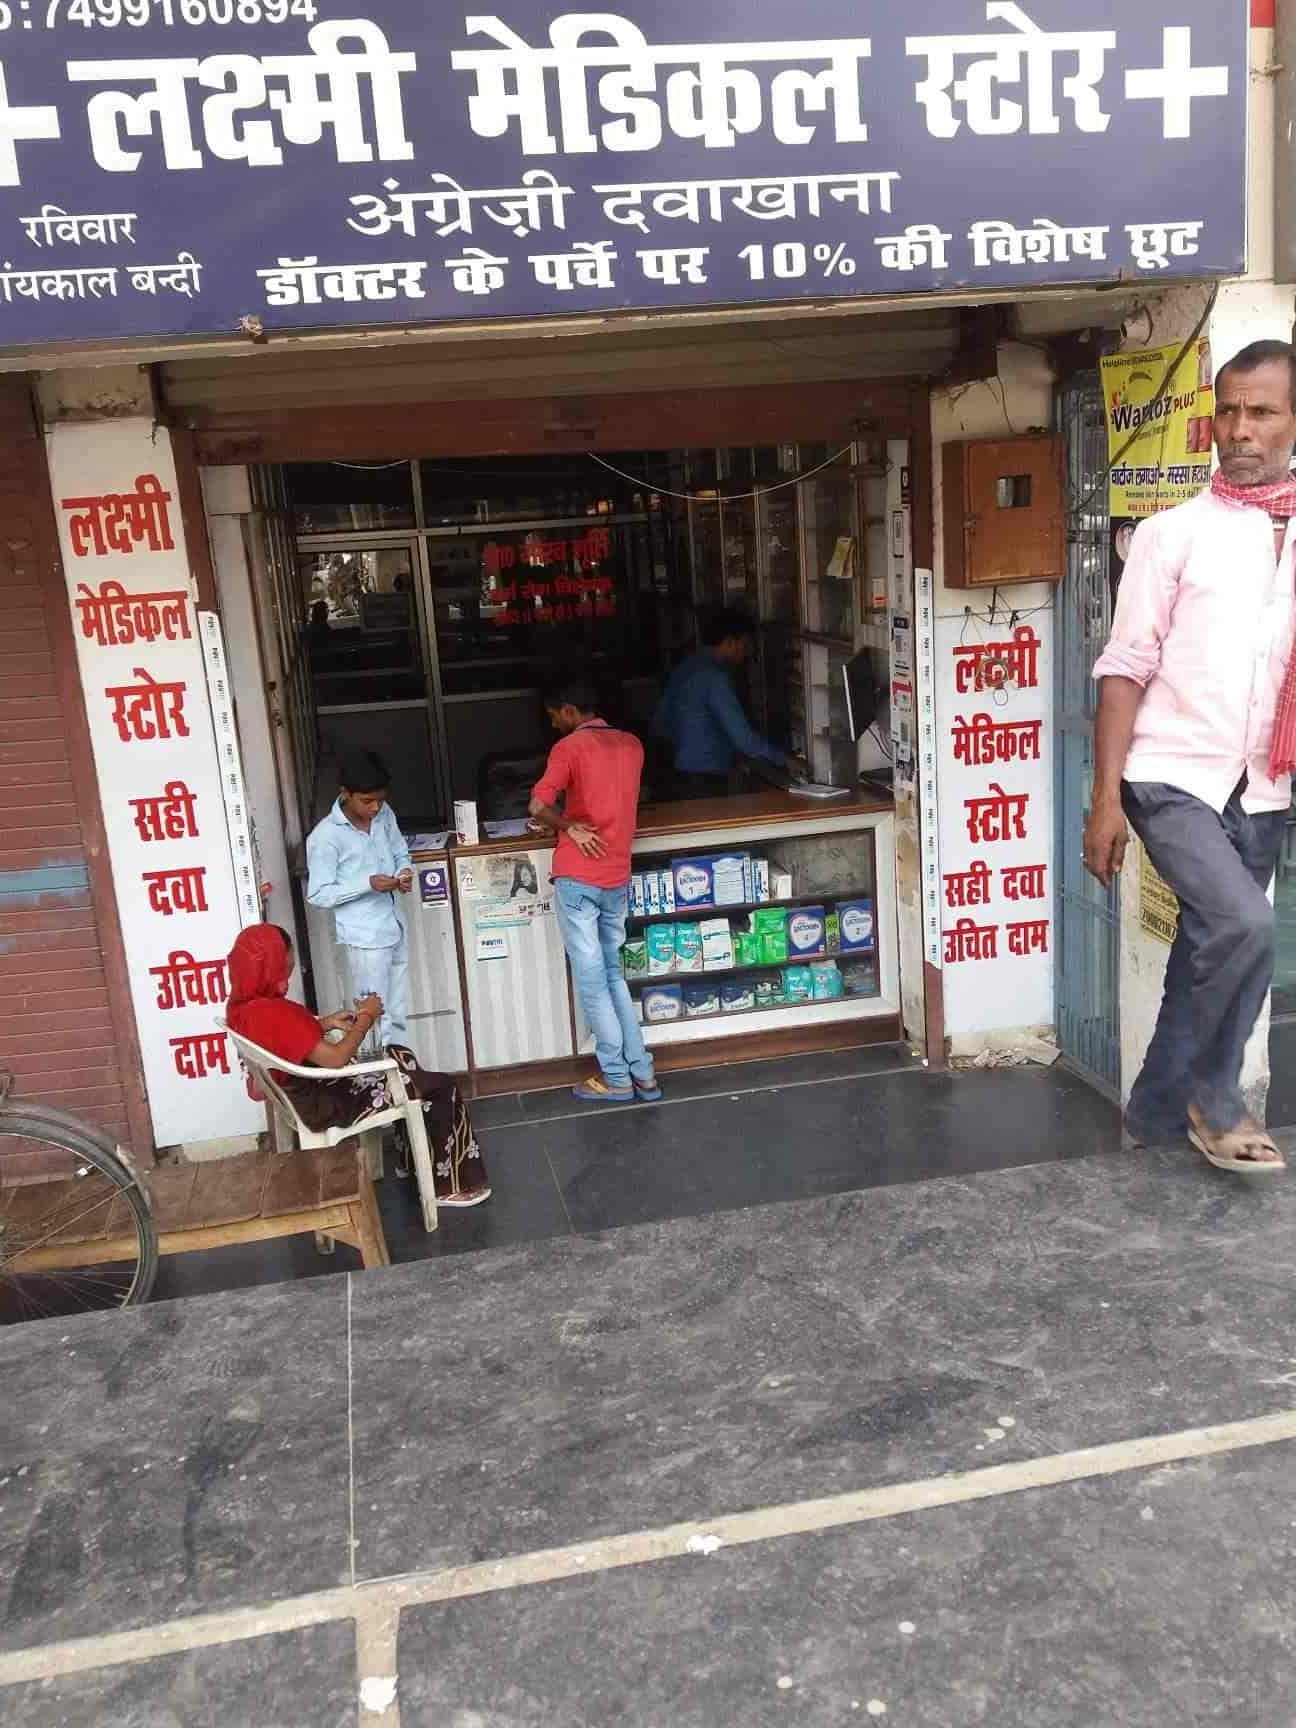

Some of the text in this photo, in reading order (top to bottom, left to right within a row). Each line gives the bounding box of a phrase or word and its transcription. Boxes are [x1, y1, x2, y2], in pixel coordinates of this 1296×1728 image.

[67, 1, 1116, 172] लक्ष्मी मेडिकल स्टोर
[19, 205, 137, 247] रविवार
[347, 170, 901, 238] अंग्रेज़ी दवाखाना
[0, 252, 203, 302] ांयकाल बन्दी
[256, 218, 1204, 306] डॉक्टर के पर्चे पर 10% की विशेष छूट
[1173, 389, 1196, 413] PLUS
[62, 474, 174, 557] लक्ष्मी
[76, 580, 192, 645] मेडिकल
[953, 625, 1041, 693] लक्ष्मी
[105, 667, 189, 742] स्टोर
[952, 713, 1042, 766] मेडिकल
[128, 780, 199, 841] सही
[964, 784, 1029, 844] स्टोर
[142, 867, 208, 916] दवा
[943, 860, 1047, 907] सही दवा
[943, 918, 1049, 963] उचित दाम
[149, 951, 227, 1010] उचित
[169, 1032, 230, 1079] दाम
